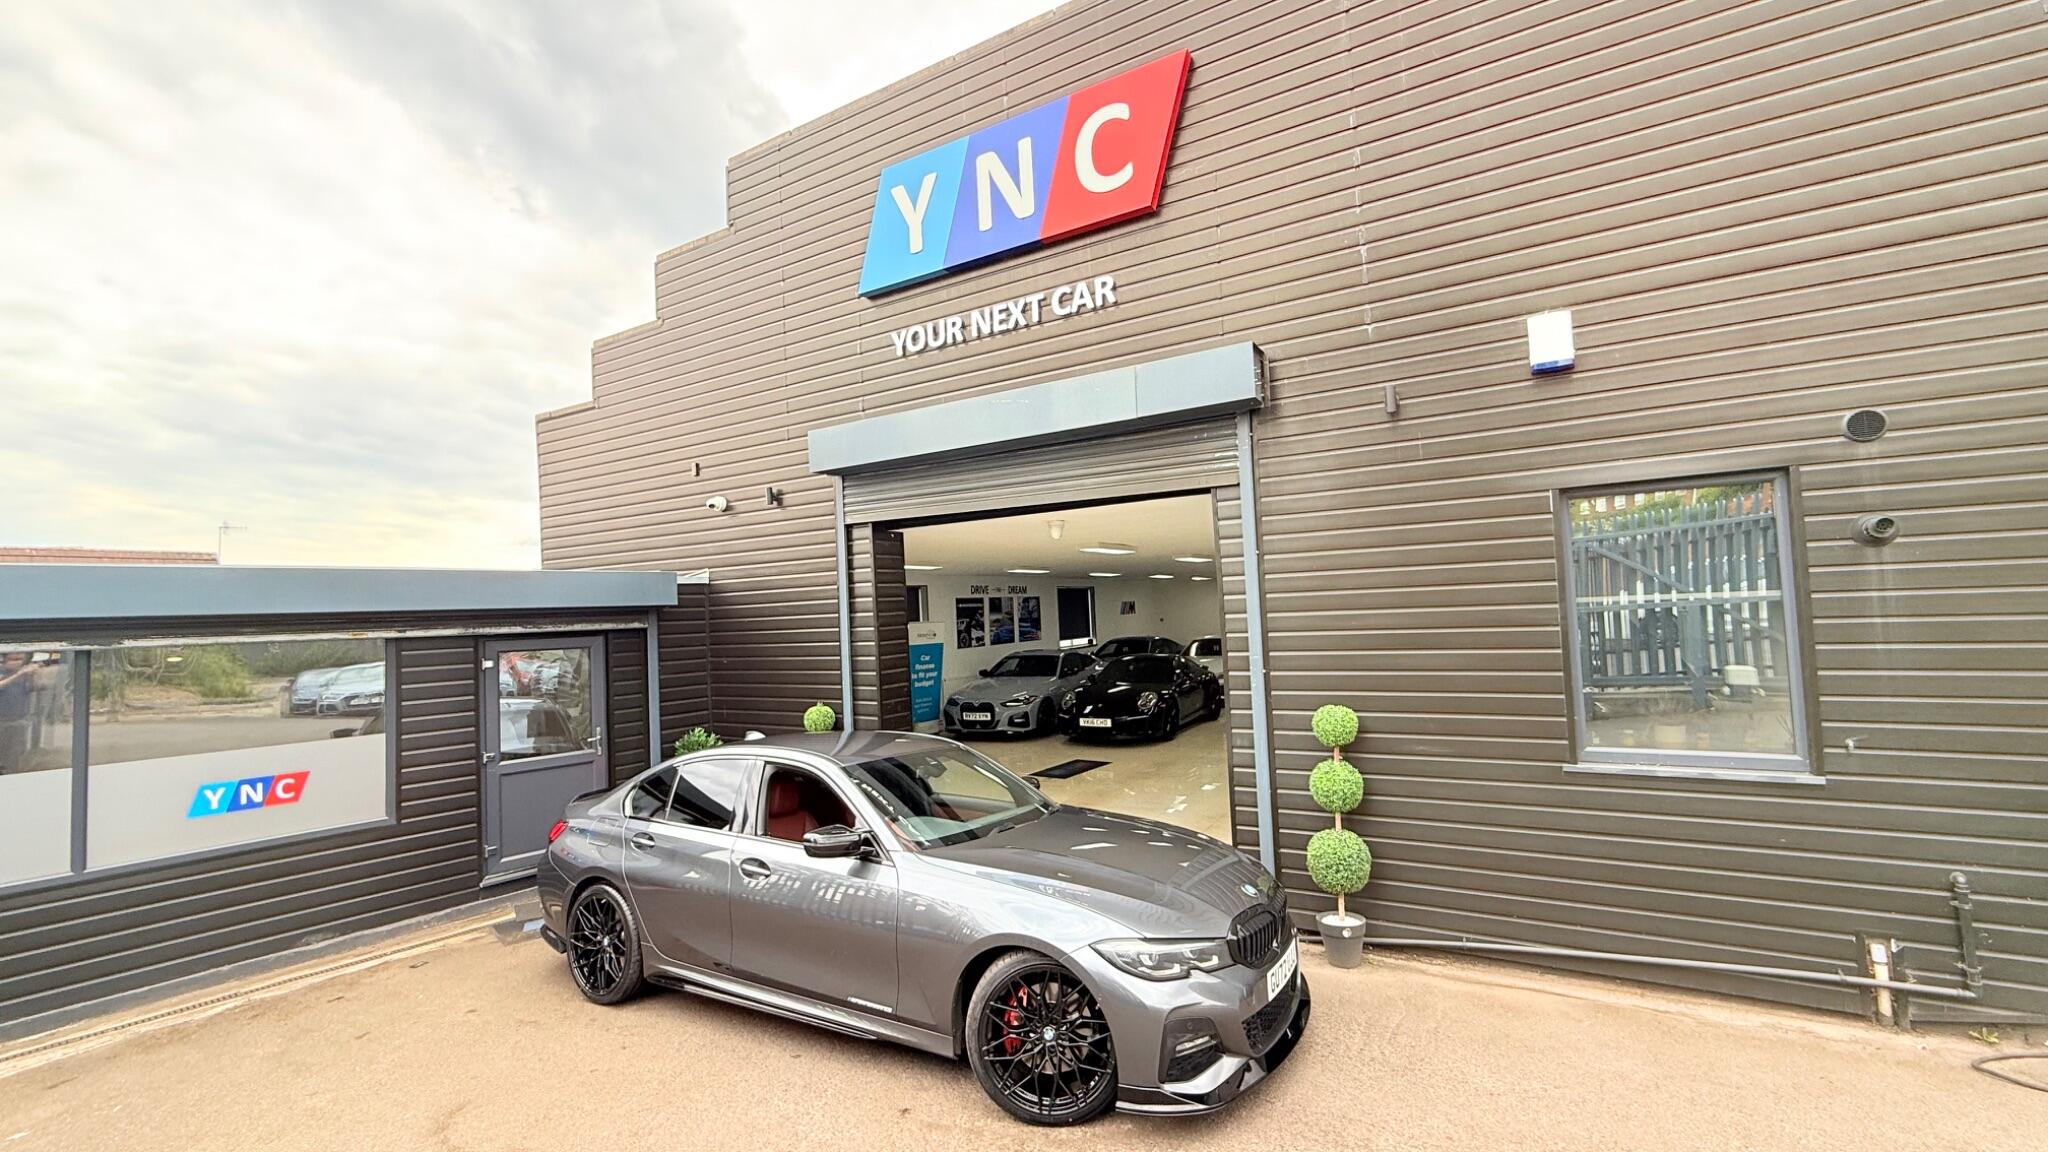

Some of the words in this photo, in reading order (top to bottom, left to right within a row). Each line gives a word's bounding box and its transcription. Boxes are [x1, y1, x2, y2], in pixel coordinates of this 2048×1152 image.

[890, 102, 1134, 254] YNC
[890, 315, 964, 358] YOUR
[970, 293, 1045, 337] NEXT
[1050, 275, 1117, 316] CAR
[970, 585, 990, 594] DRIVE
[1007, 585, 1028, 595] DREAM
[203, 777, 296, 810] YNC
